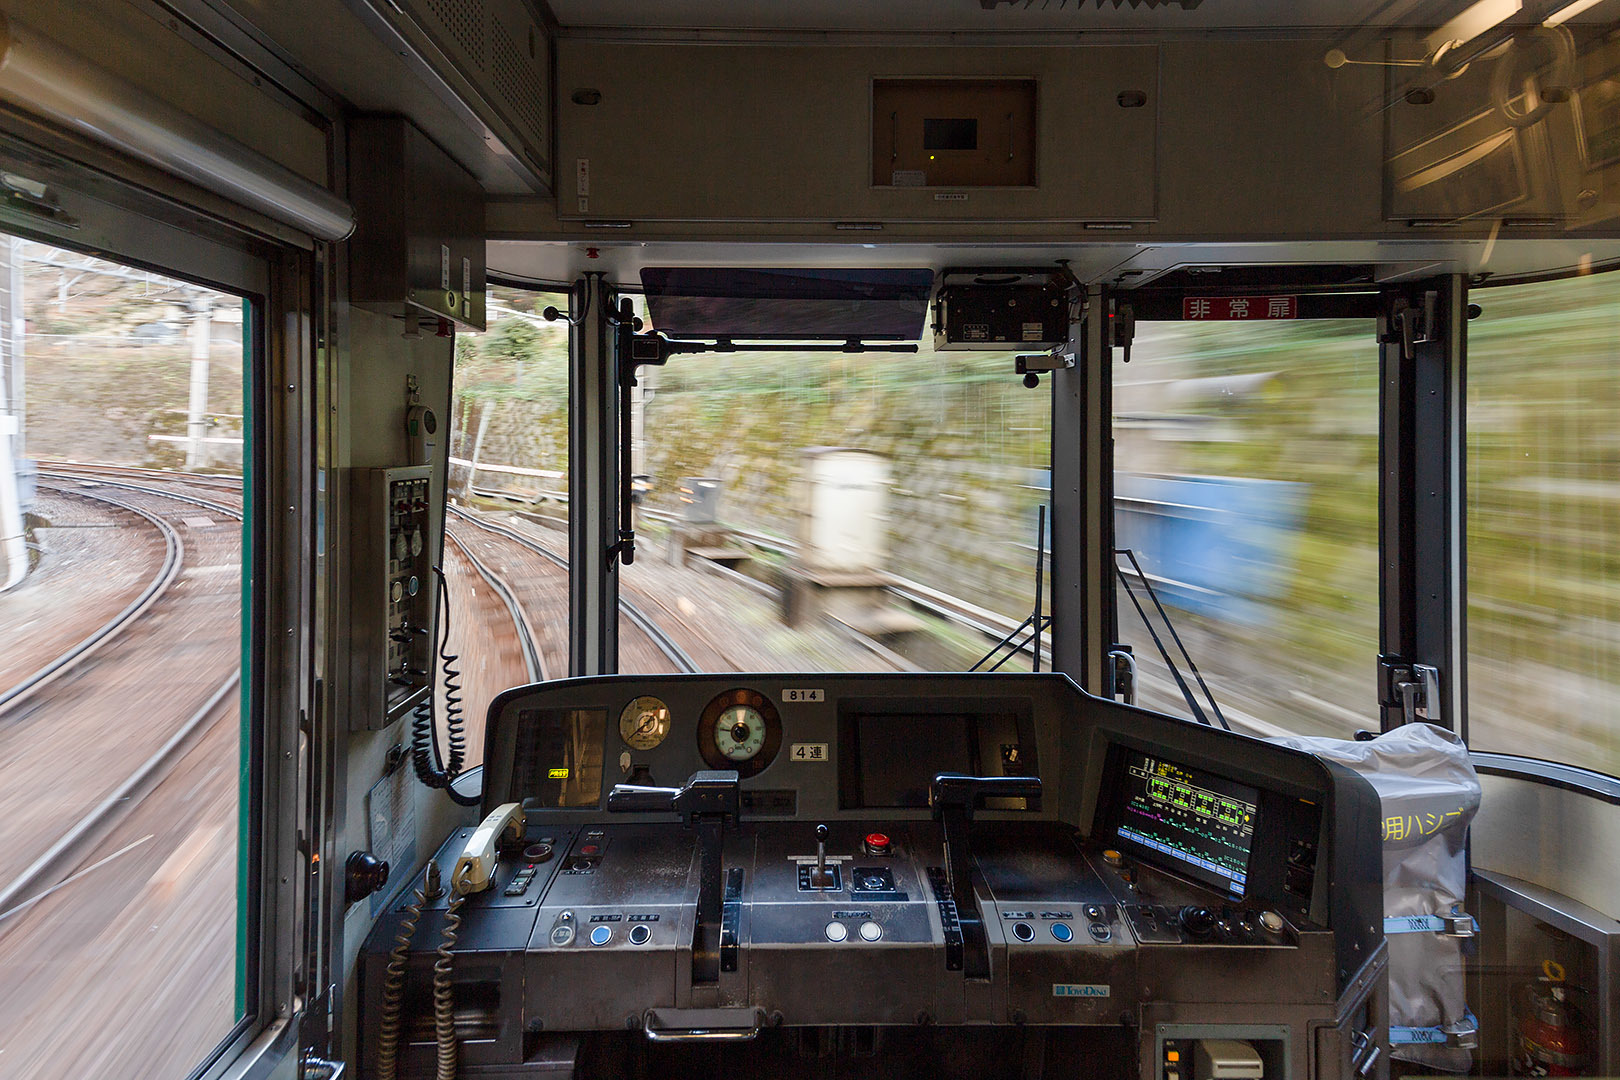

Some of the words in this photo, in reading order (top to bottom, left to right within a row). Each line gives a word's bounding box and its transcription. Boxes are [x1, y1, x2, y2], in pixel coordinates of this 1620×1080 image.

[1189, 298, 1290, 319] 非常扉
[789, 690, 818, 701] 814
